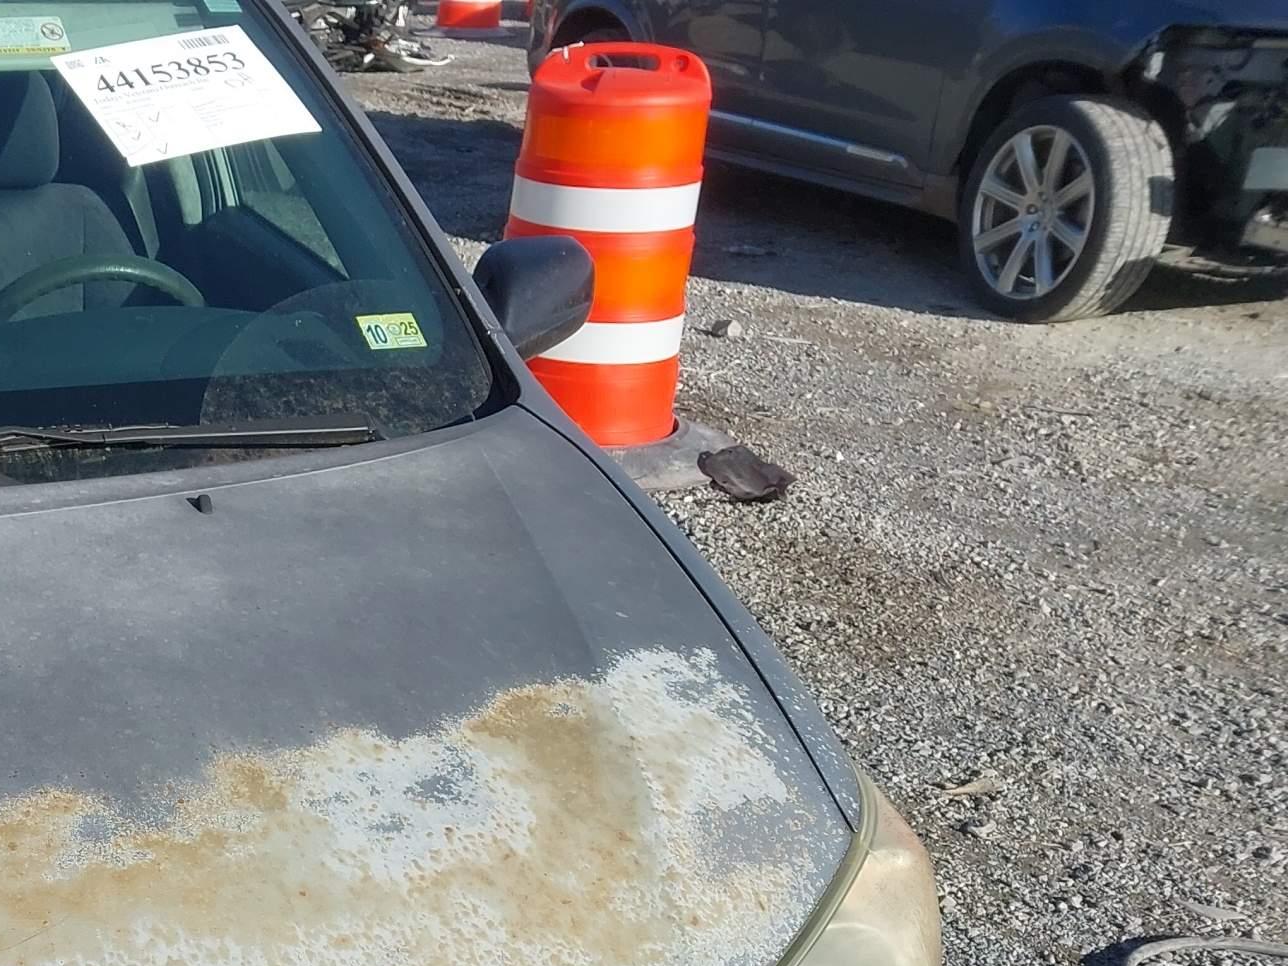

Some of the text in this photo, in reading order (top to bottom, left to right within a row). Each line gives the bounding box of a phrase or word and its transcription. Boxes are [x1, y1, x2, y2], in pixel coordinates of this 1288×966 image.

[96, 51, 246, 94] 44153853
[366, 323, 388, 345] 10
[399, 321, 419, 336] 25
